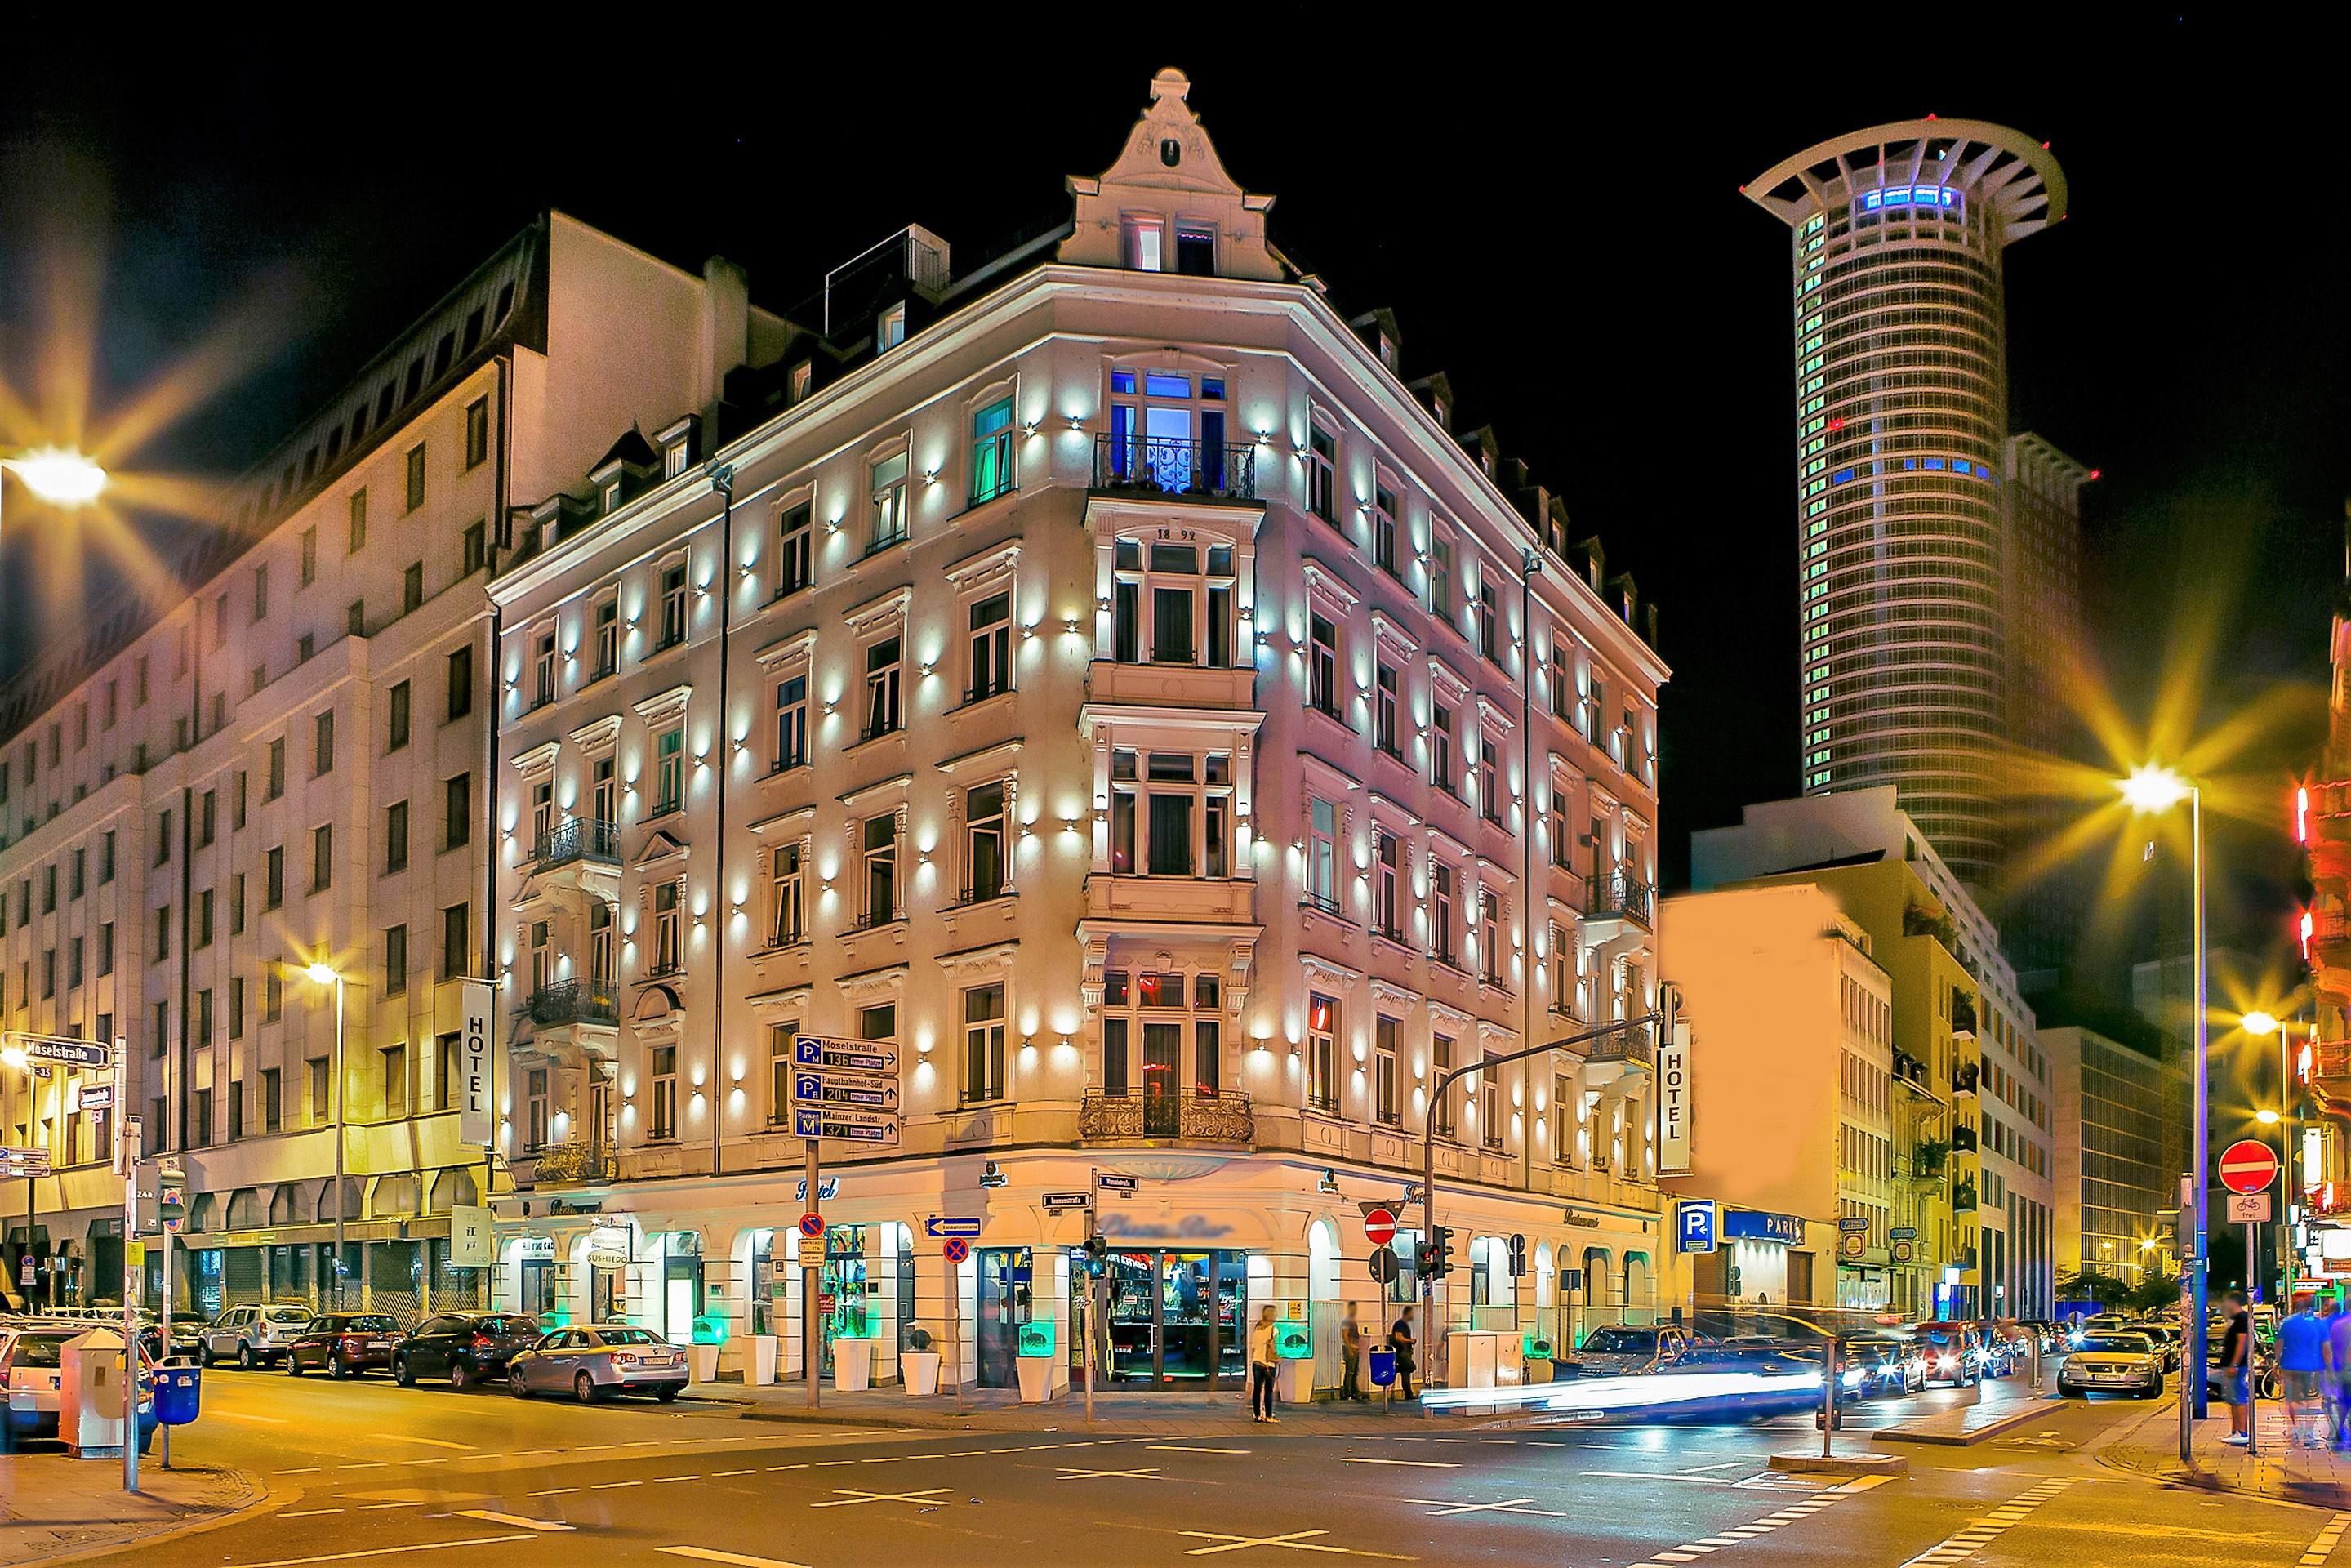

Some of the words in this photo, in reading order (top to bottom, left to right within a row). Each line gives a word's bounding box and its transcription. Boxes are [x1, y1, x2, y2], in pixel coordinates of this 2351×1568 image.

[1158, 528, 1170, 539] 18
[25, 1041, 88, 1061] Moselstraße
[804, 1045, 813, 1059] P
[823, 1040, 878, 1054] Moselstraße
[468, 1017, 483, 1112] HOTEL
[829, 1053, 848, 1066] 136
[804, 1081, 813, 1095] P
[1667, 1054, 1682, 1139] HOTEL
[823, 1111, 853, 1121] Mainzer
[855, 1113, 883, 1124] Landstr.
[802, 1120, 815, 1134] M
[1686, 1212, 1706, 1235] P
[588, 1253, 627, 1263] SUSHIEDO
